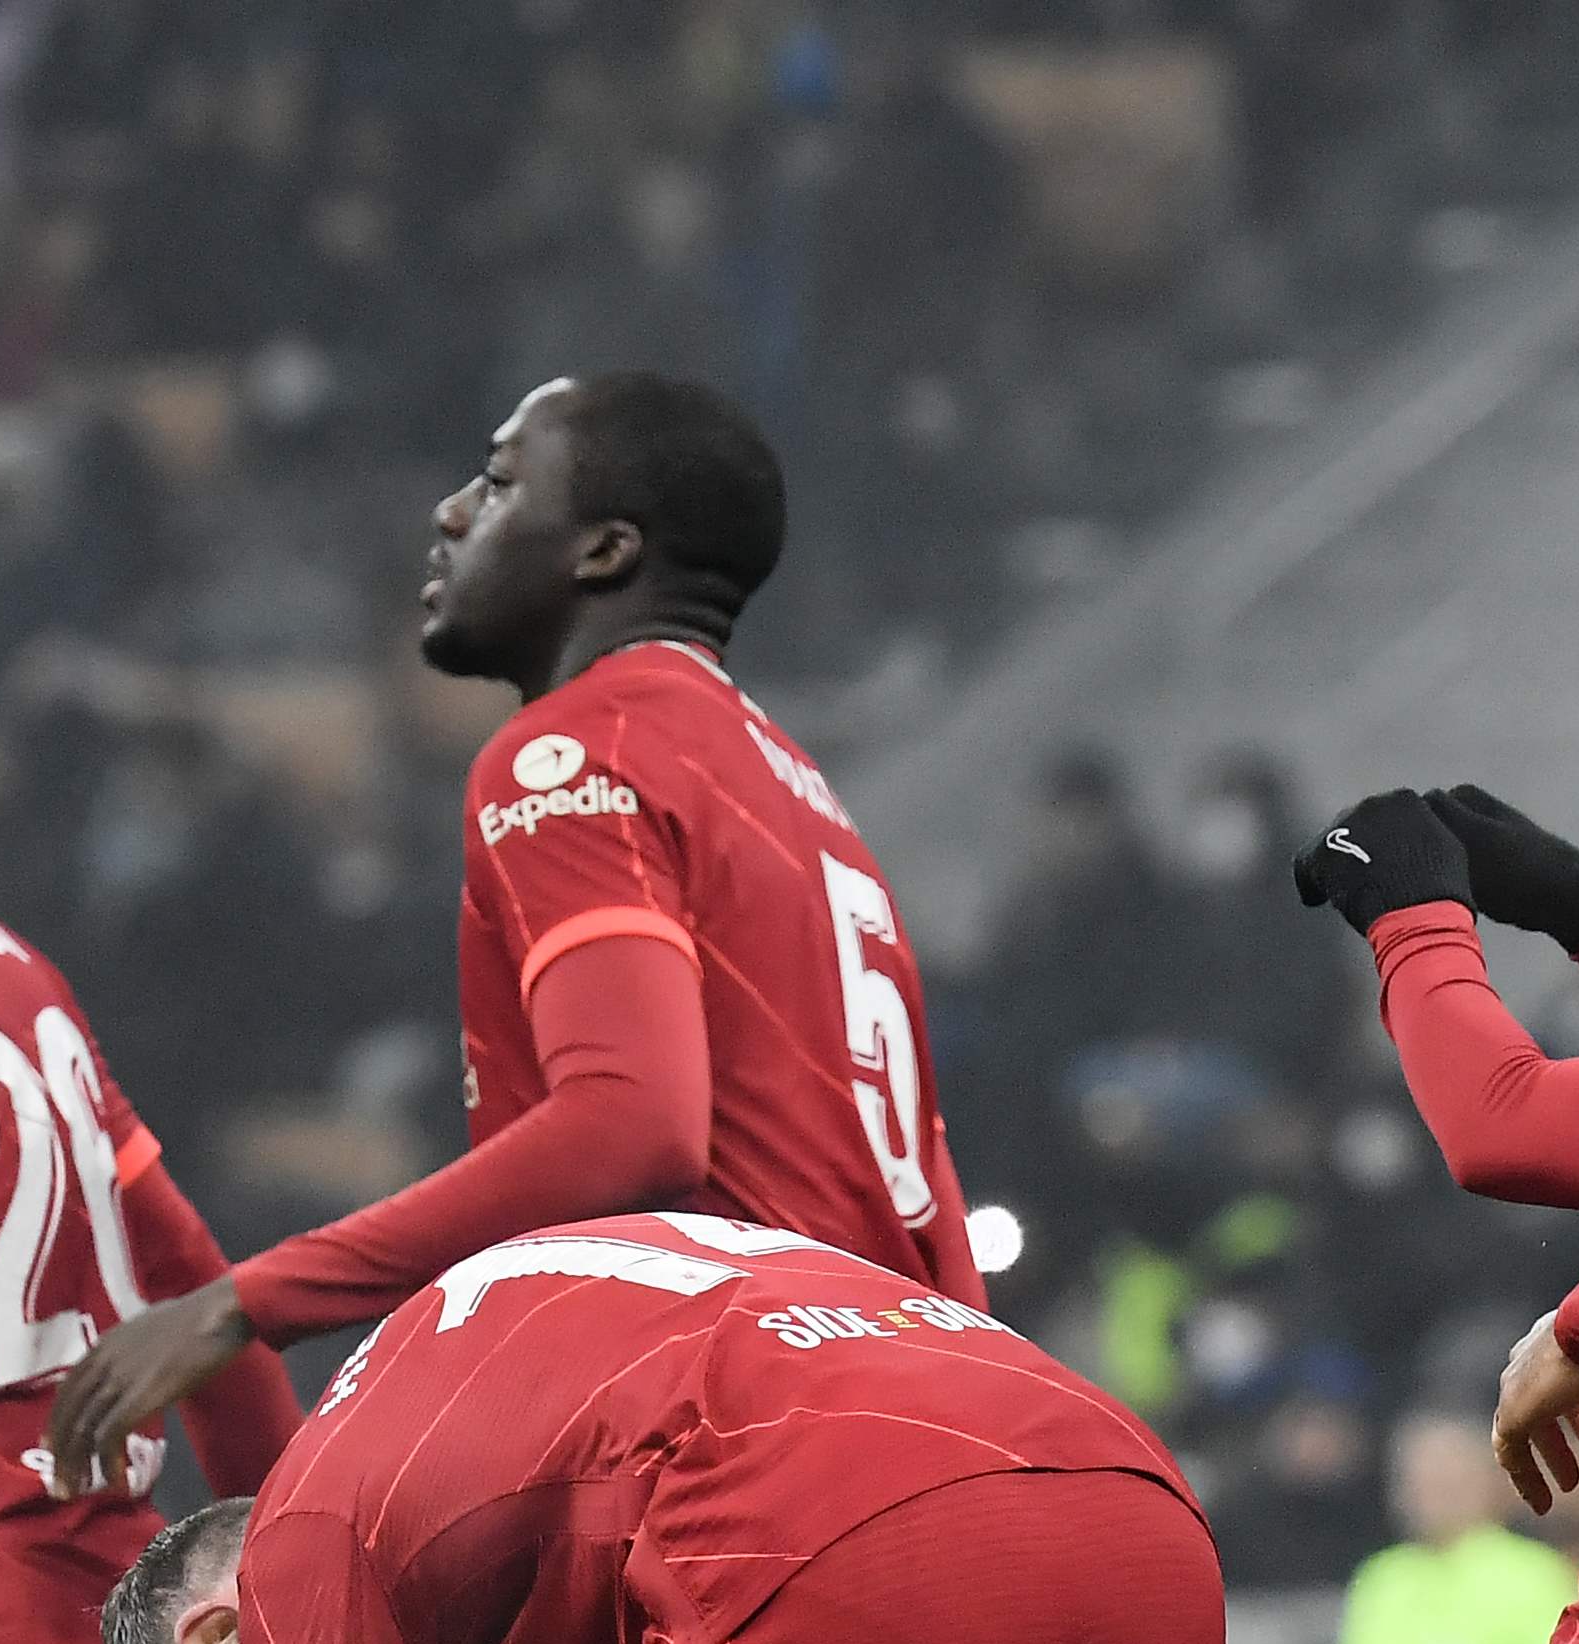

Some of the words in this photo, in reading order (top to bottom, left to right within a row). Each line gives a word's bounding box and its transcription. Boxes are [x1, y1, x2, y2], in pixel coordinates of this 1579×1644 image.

[478, 776, 638, 846] Expedia
[819, 850, 937, 1228] 5
[758, 1305, 898, 1349] SIDE
